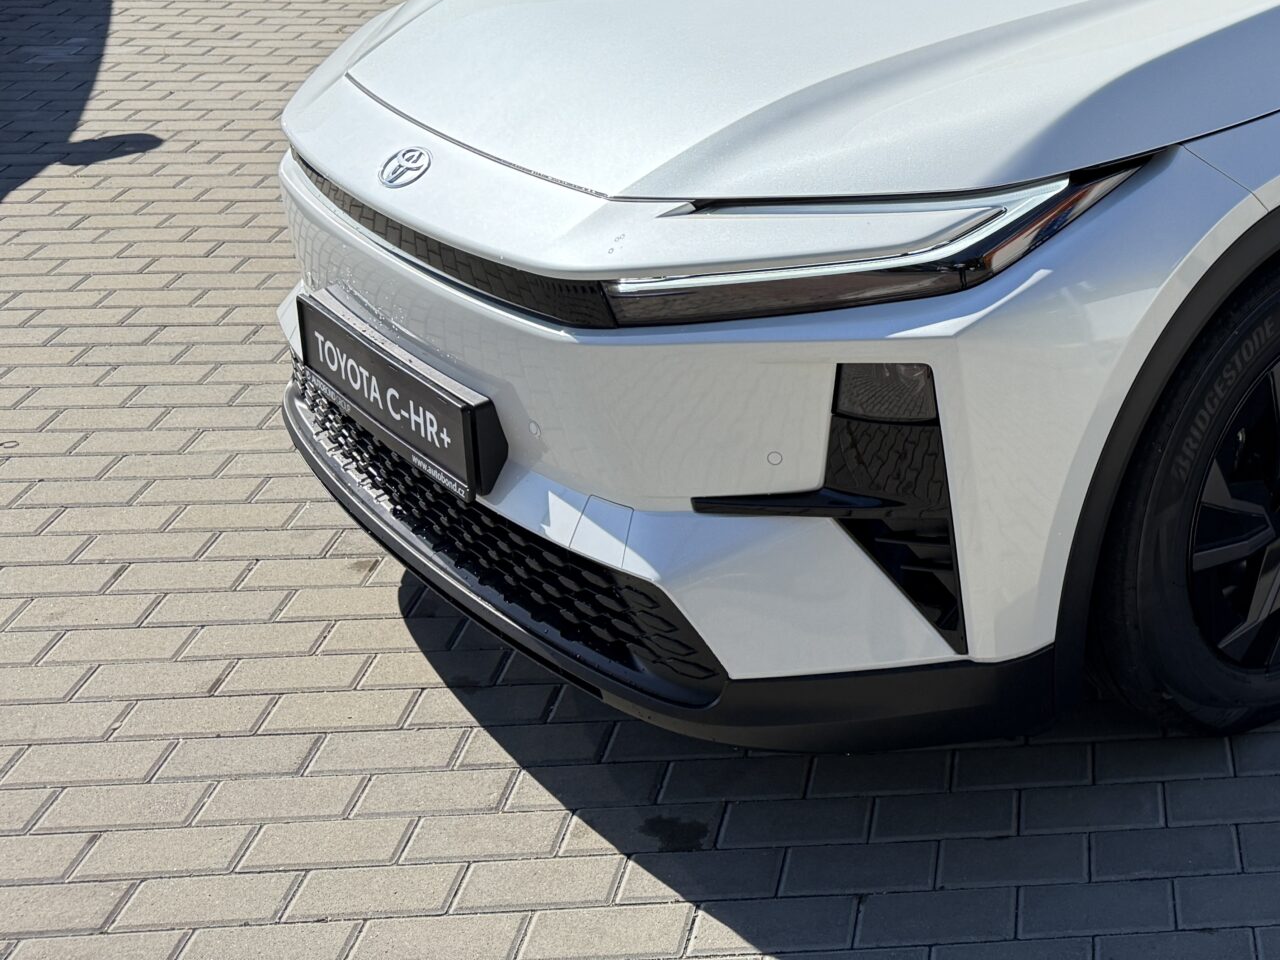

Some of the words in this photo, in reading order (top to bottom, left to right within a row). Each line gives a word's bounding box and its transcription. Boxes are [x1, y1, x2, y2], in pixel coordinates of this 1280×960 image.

[314, 331, 384, 410] TOYOTA
[386, 387, 452, 449] C-HR+
[1171, 315, 1276, 484] BRIDGESTONE
[411, 454, 466, 499] www.autobond.cz
